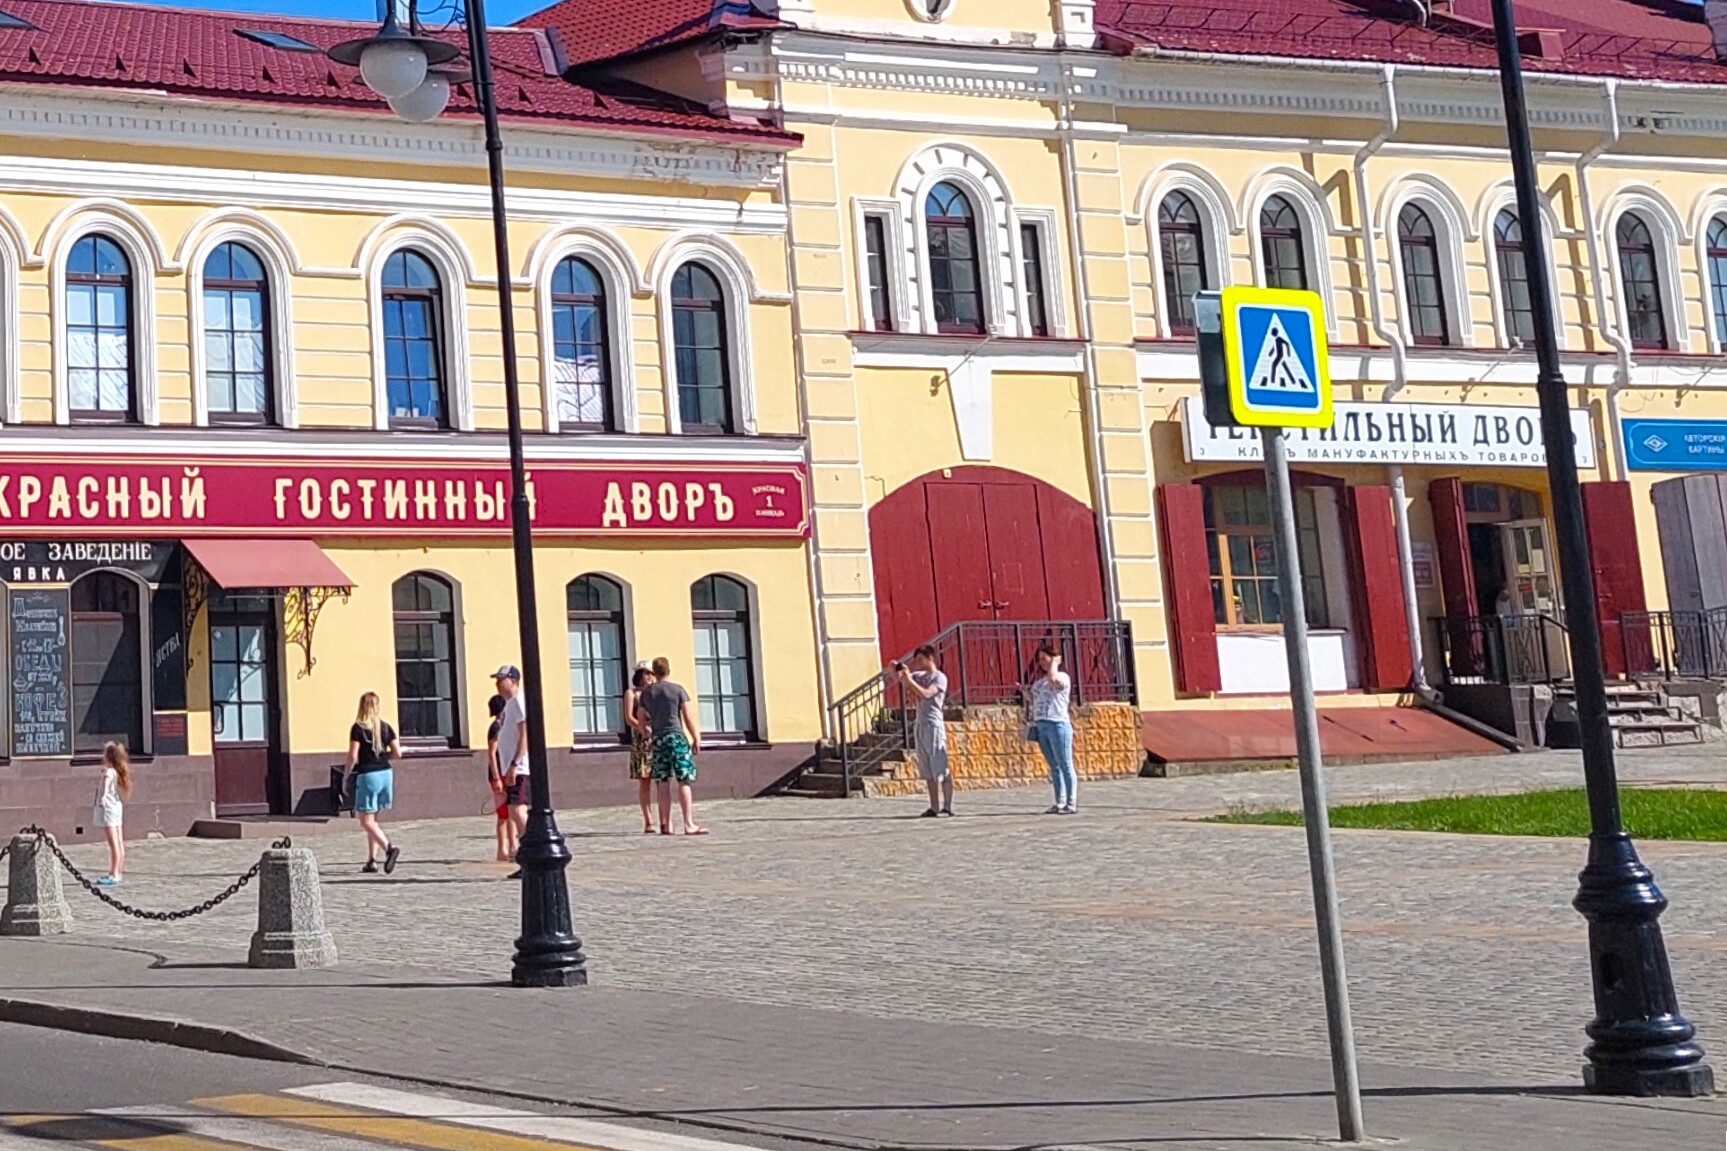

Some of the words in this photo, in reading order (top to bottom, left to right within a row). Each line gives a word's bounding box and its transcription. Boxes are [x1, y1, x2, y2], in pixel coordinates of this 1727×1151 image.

[1473, 415, 1577, 446] ДВО
[1308, 449, 1469, 461] МАНУФАКТУРНЫХЪ
[602, 482, 734, 527] ДВОРЪ
[766, 495, 774, 507] 1
[13, 567, 66, 581] ЯВКА
